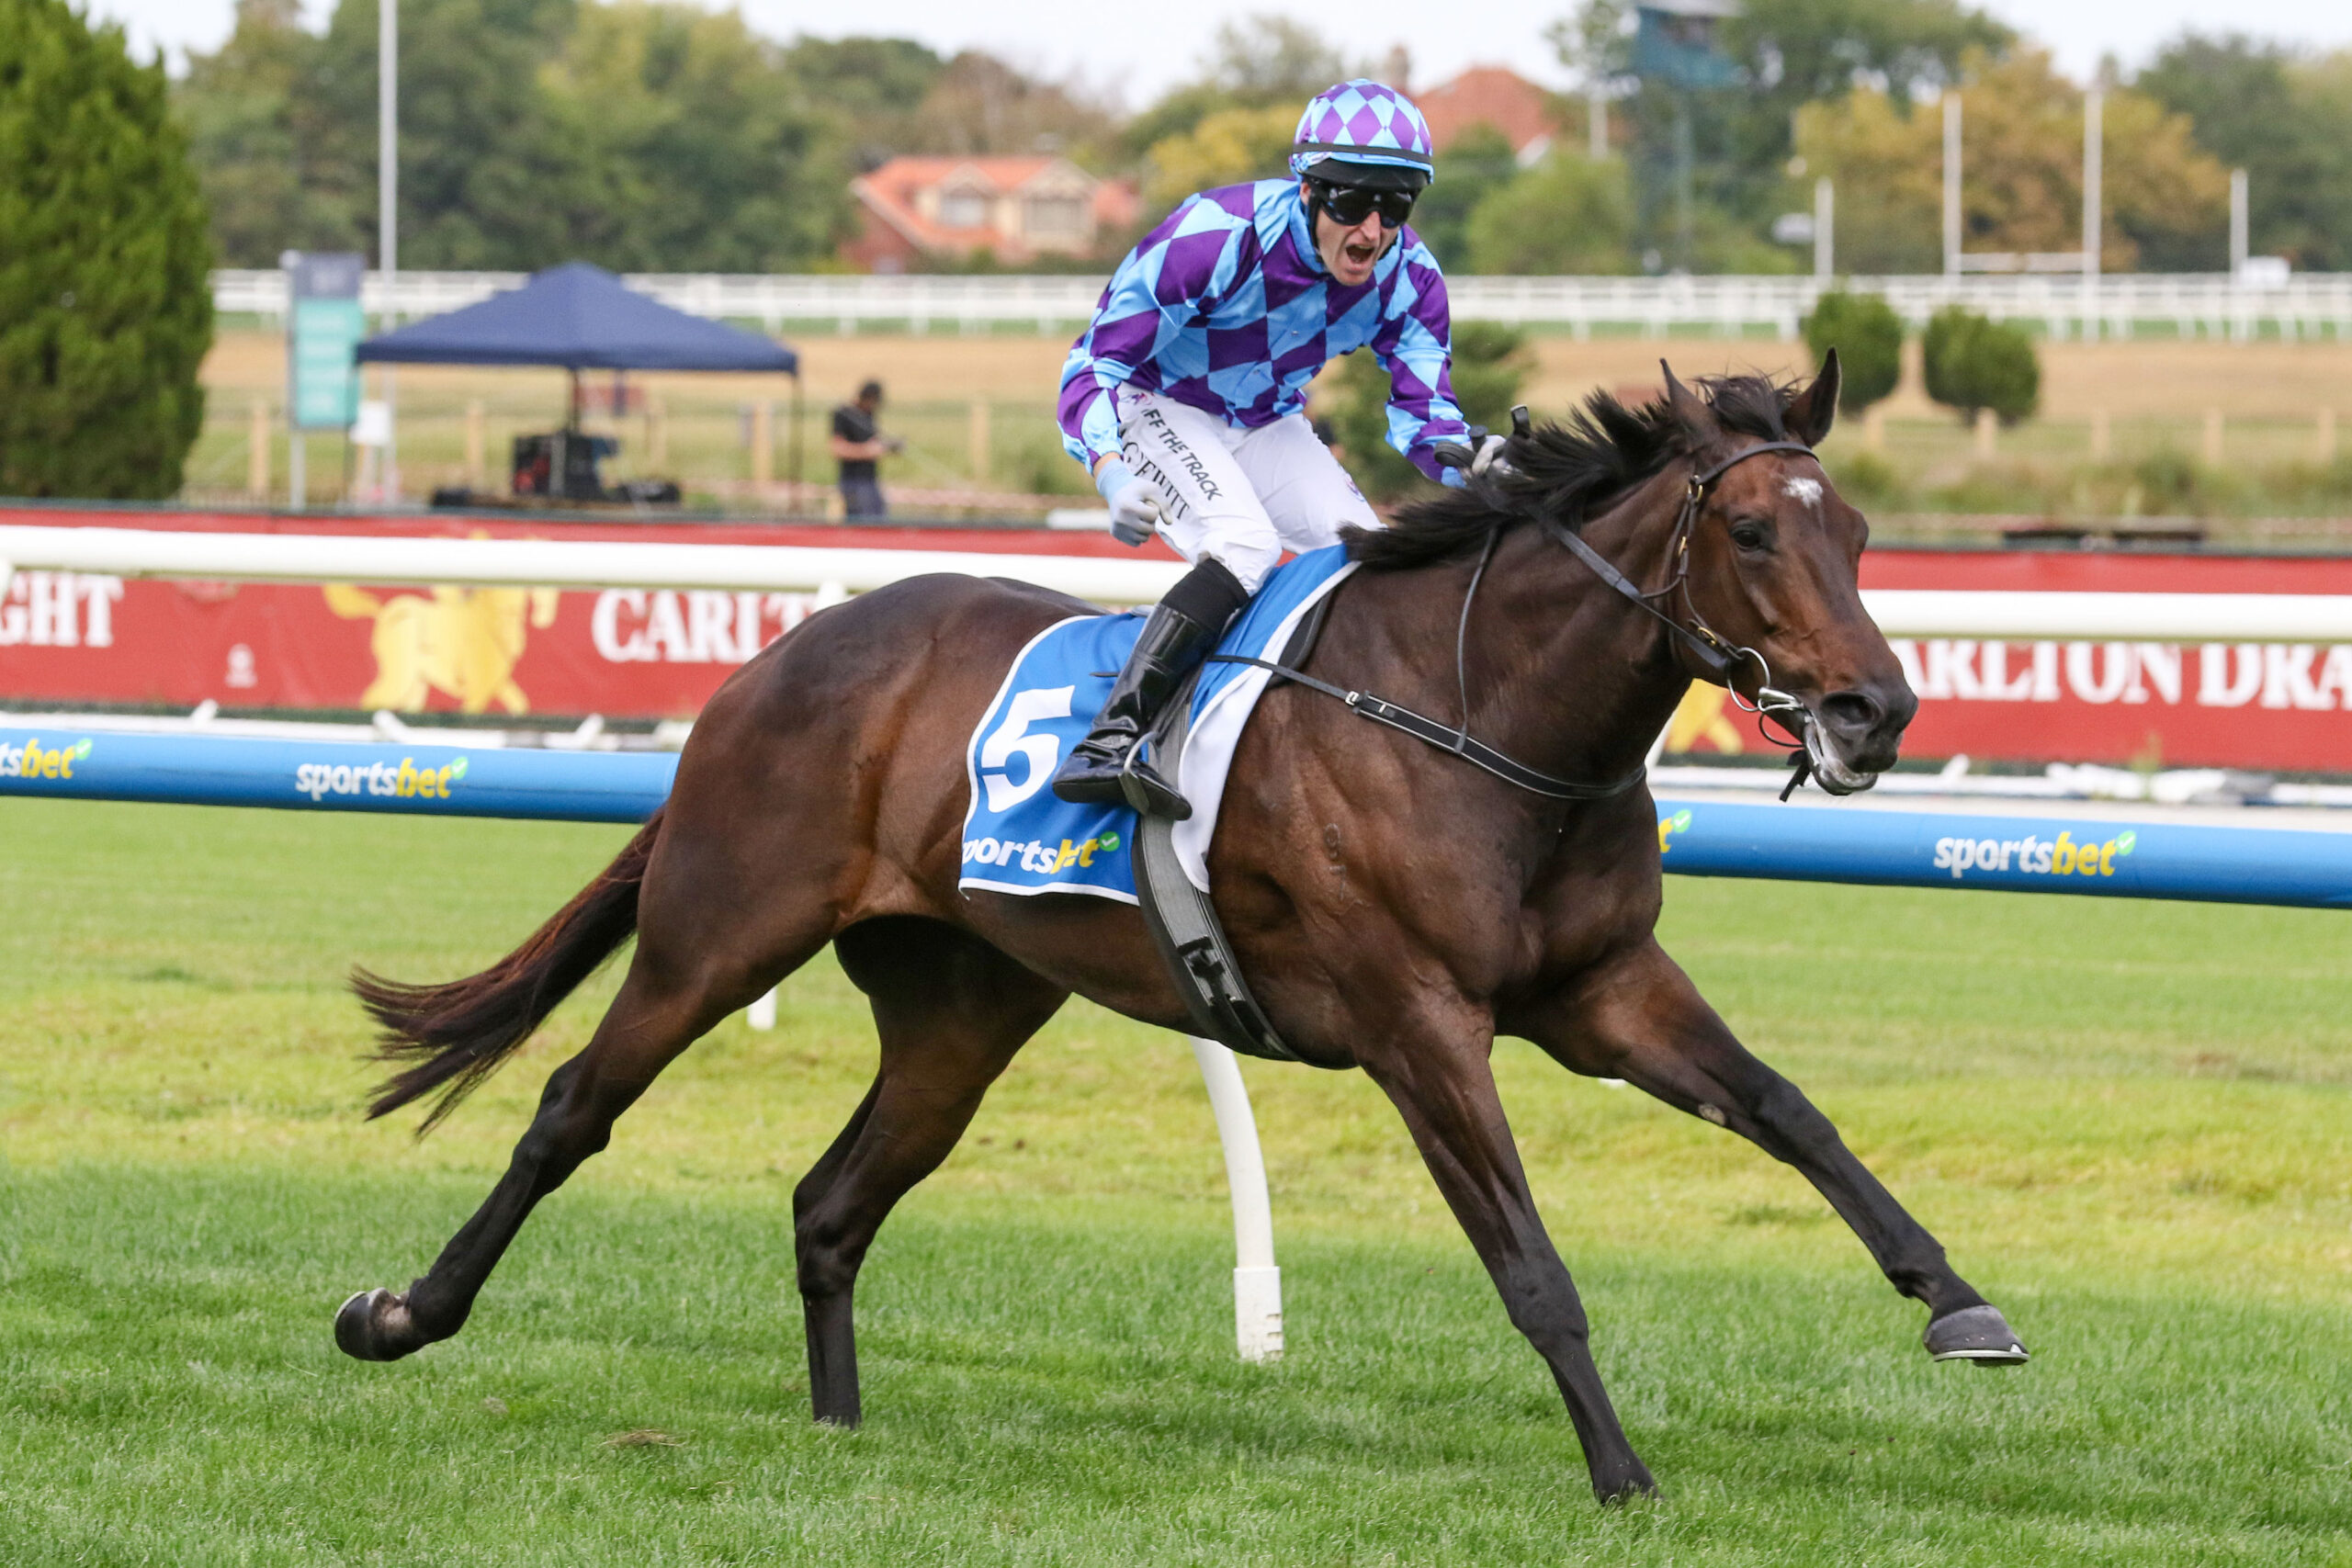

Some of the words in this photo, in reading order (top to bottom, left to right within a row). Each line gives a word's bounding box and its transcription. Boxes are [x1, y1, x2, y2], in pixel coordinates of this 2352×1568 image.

[1141, 408, 1166, 429] FF
[1159, 428, 1189, 455] THE
[1181, 452, 1224, 502] TRACK
[295, 757, 453, 802] sportsbet
[980, 684, 1076, 814] 5
[1933, 830, 2118, 879] sportsbet
